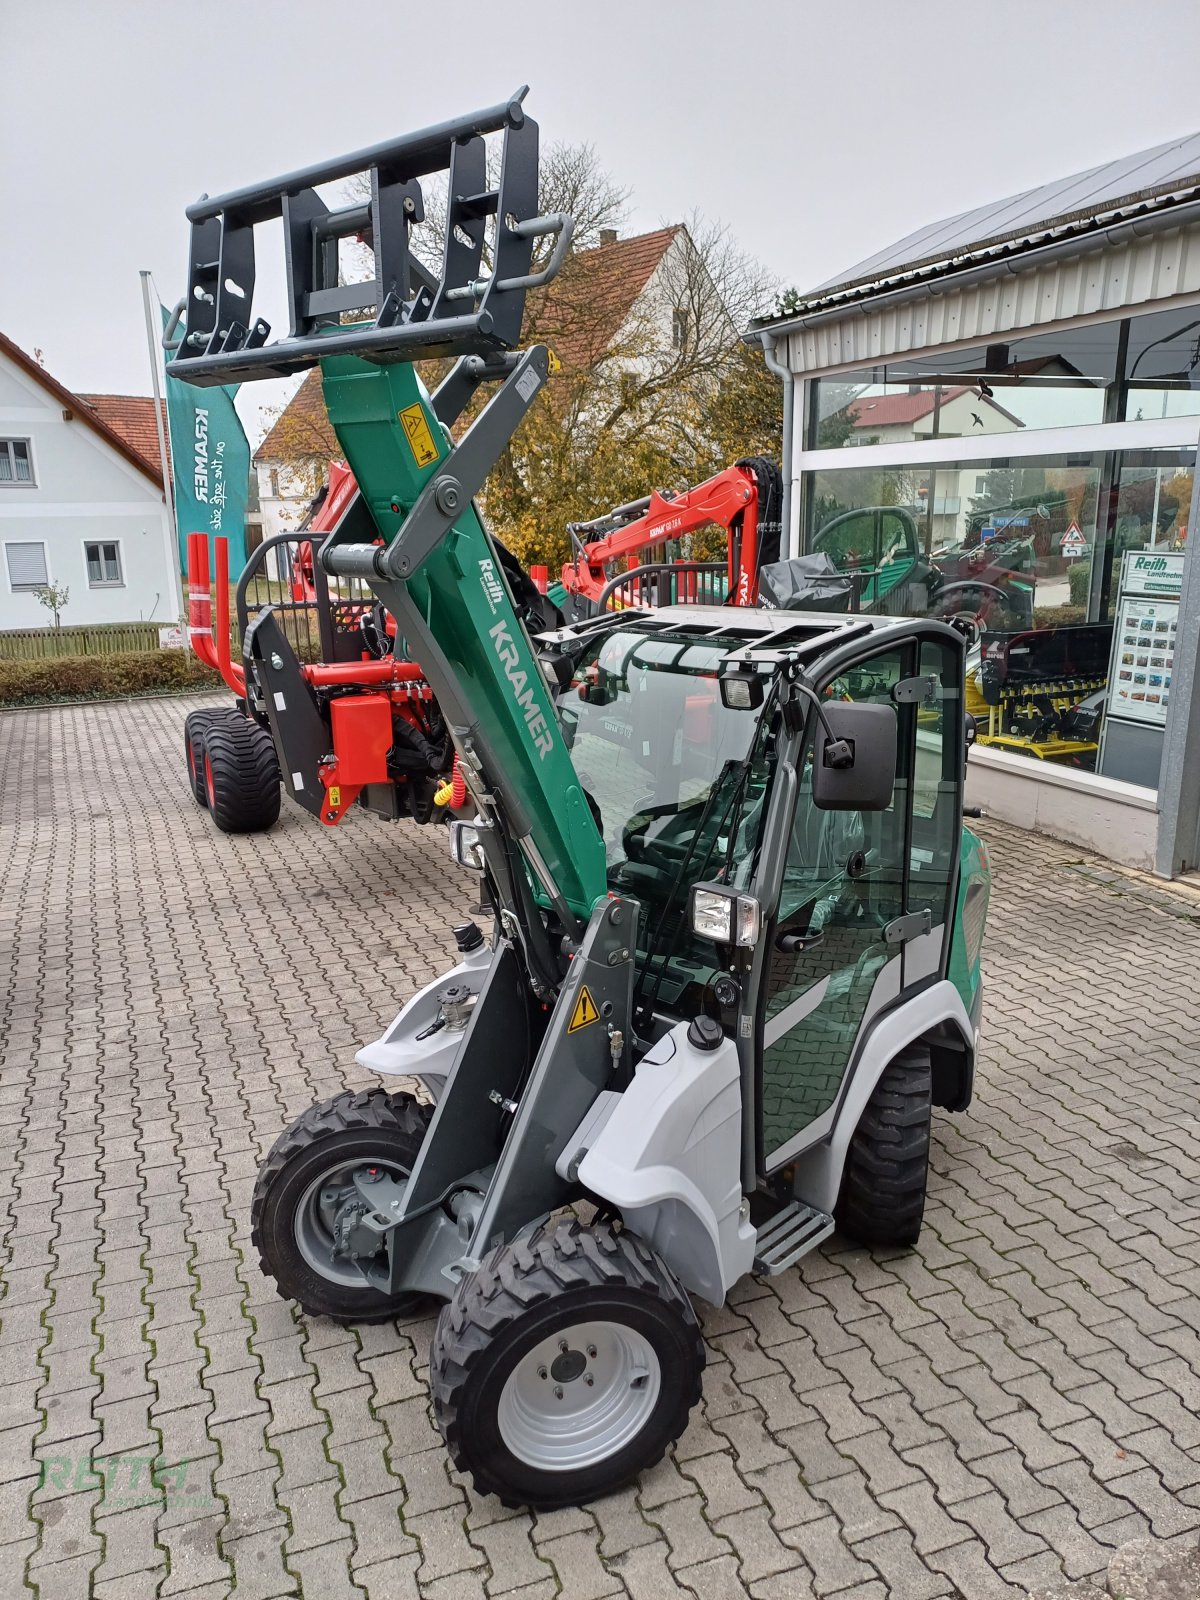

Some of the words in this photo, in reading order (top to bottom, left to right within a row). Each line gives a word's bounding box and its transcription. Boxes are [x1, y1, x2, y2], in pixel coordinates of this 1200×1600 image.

[478, 559, 504, 603] Reith
[1134, 556, 1168, 571] Reith
[1146, 570, 1183, 579] Landtechn
[479, 576, 497, 615] Landtechnik
[489, 619, 554, 761] KRAMER
